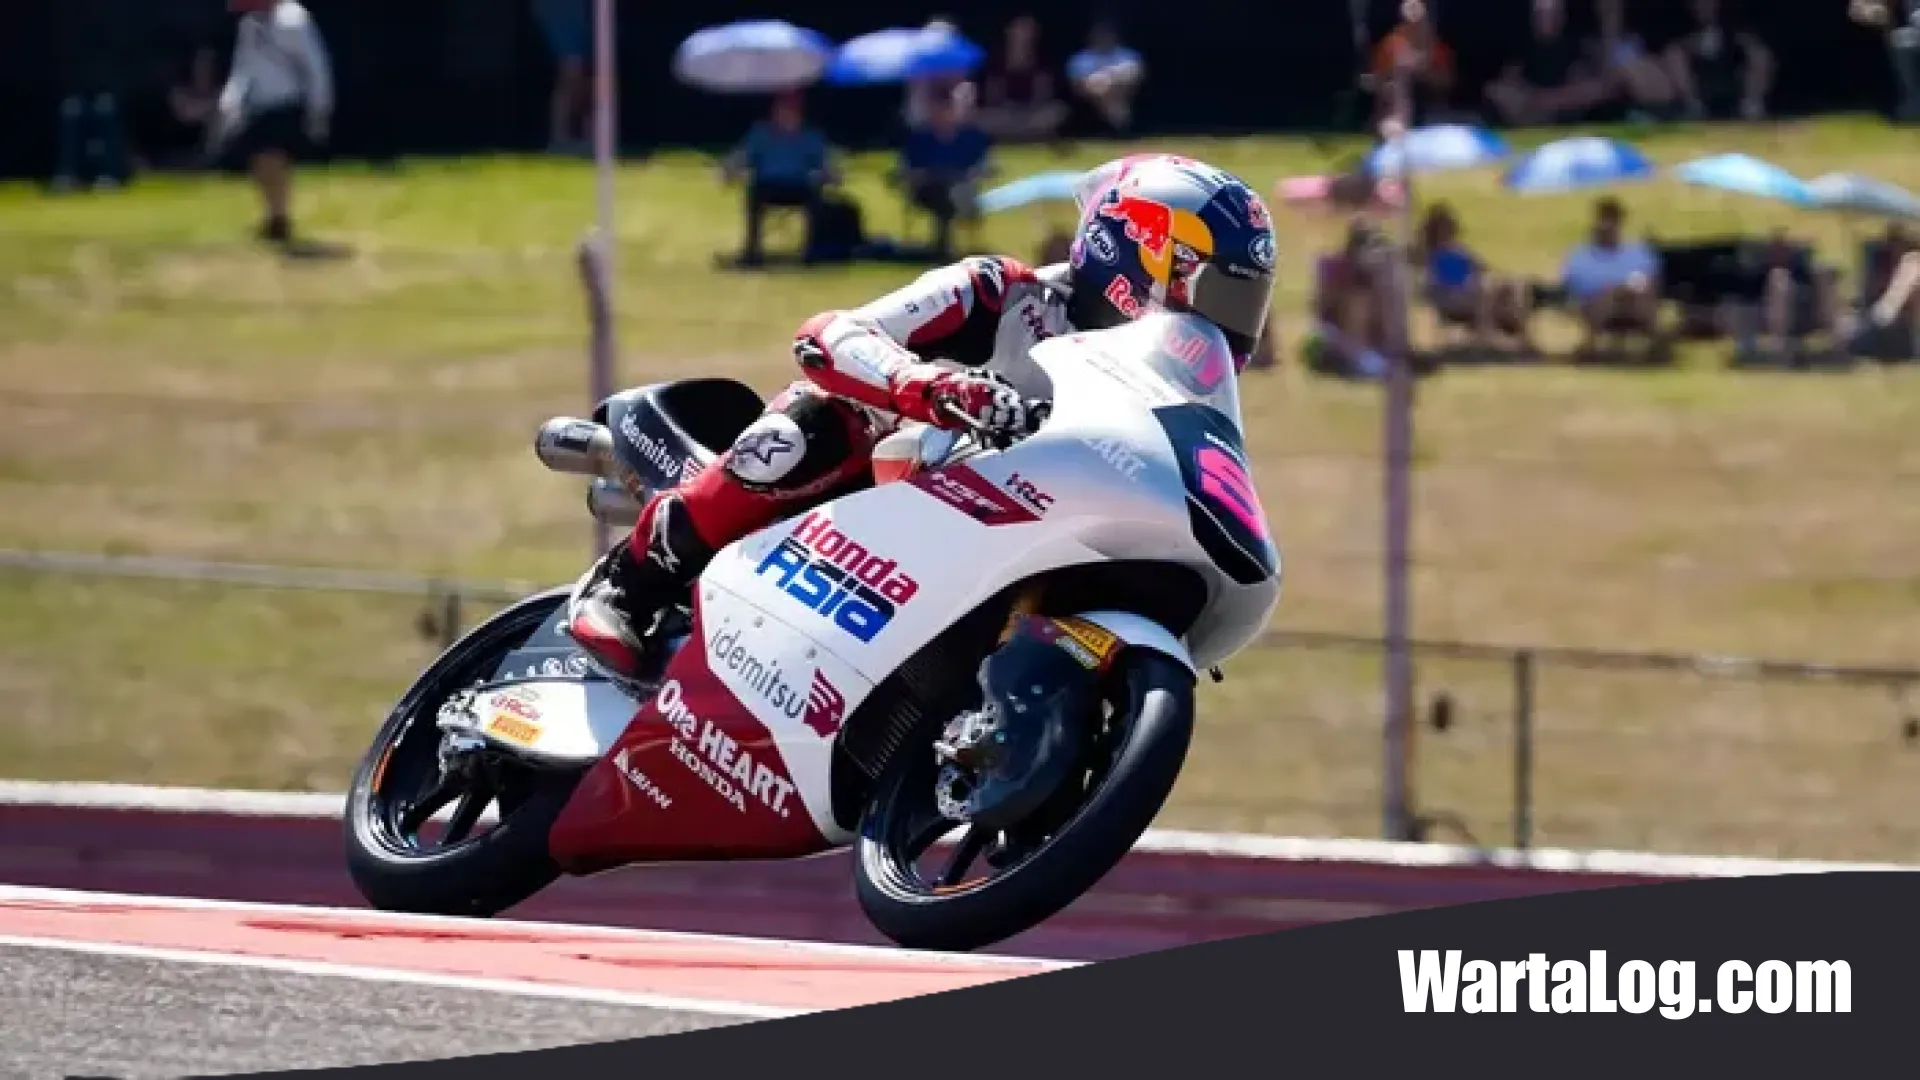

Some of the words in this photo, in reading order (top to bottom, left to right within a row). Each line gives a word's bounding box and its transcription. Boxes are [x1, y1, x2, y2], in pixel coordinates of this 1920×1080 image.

[1165, 331, 1209, 370] ull
[1006, 471, 1056, 512] HRC
[790, 511, 920, 606] Honda
[709, 615, 806, 719] idemitsu
[657, 679, 697, 739] One
[699, 720, 796, 818] HEART.
[669, 736, 747, 813] HONDA
